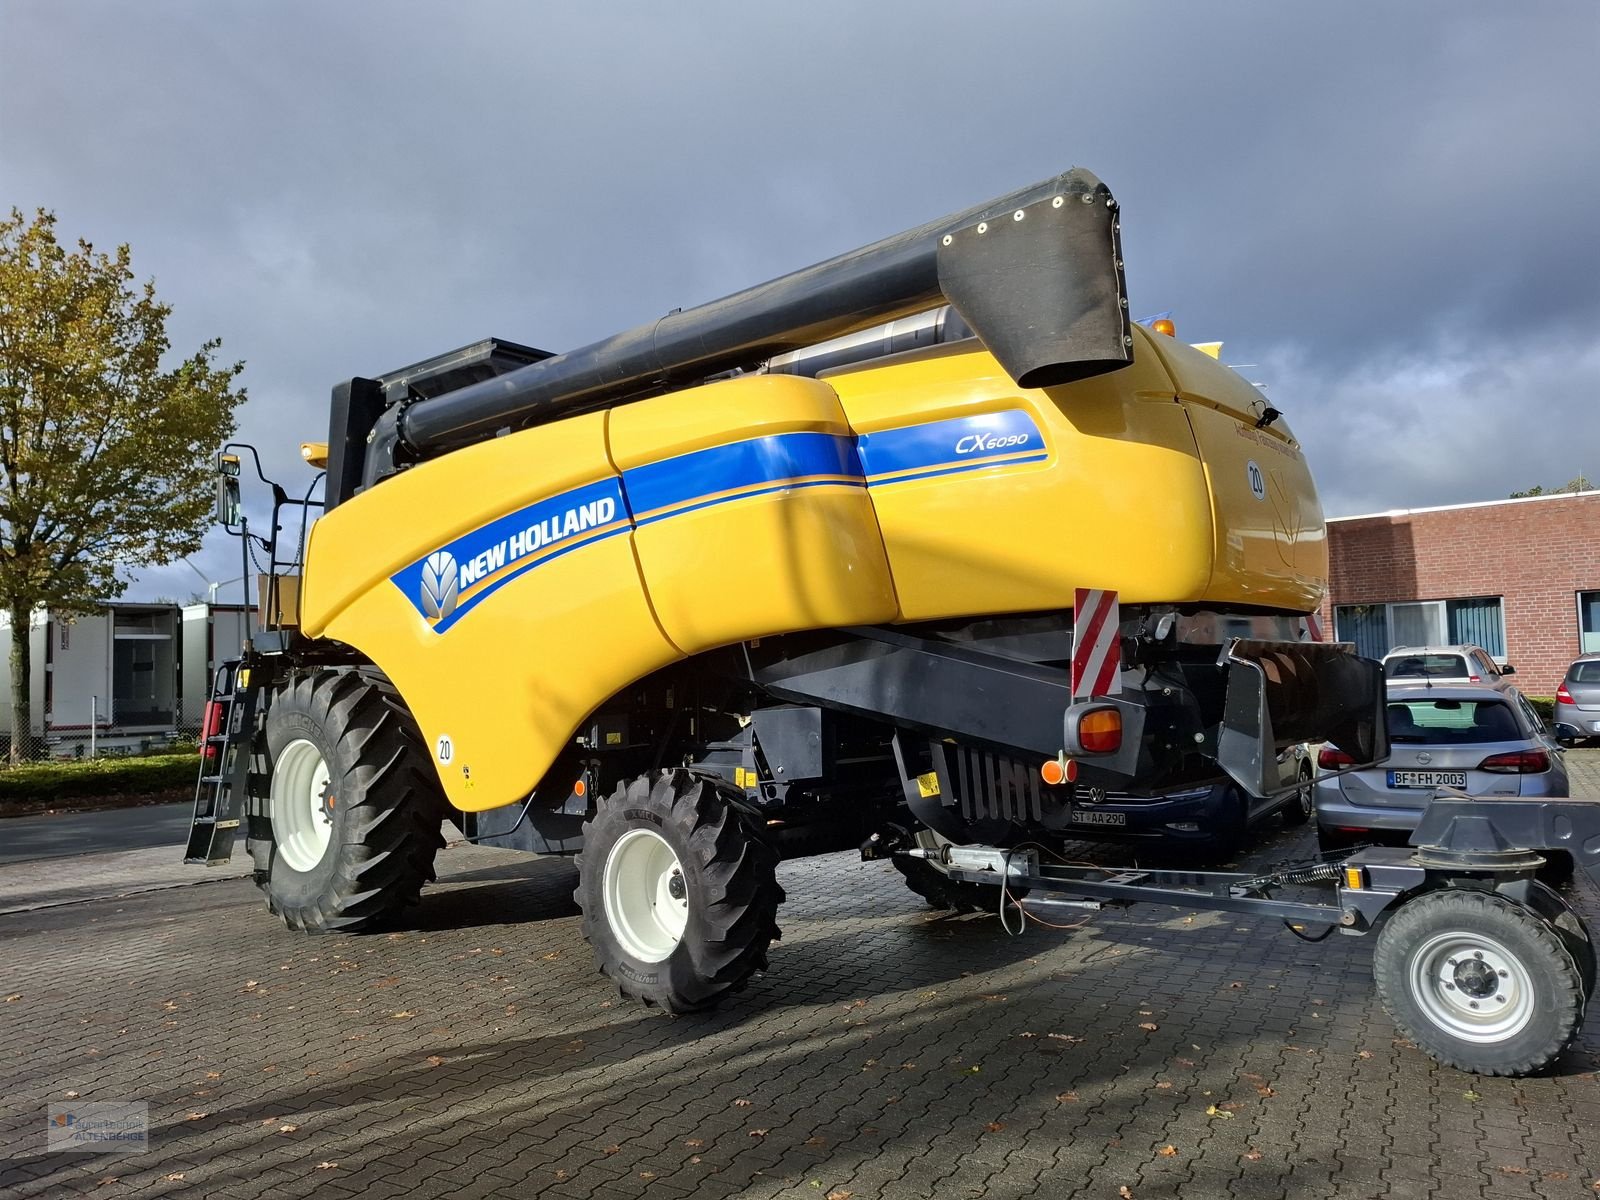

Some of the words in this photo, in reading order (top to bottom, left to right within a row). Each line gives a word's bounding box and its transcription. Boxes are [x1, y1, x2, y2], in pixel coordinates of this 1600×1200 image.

[955, 432, 1029, 454] CX6090
[1249, 465, 1263, 494] 20
[460, 540, 507, 589] NEW
[509, 497, 615, 561] HOLLAND
[440, 740, 450, 760] 20
[1395, 773, 1408, 785] BF
[1418, 773, 1433, 785] FH
[1436, 773, 1465, 786] 2003
[1073, 812, 1085, 822] ST
[1091, 813, 1104, 824] AA
[1106, 813, 1125, 825] 290
